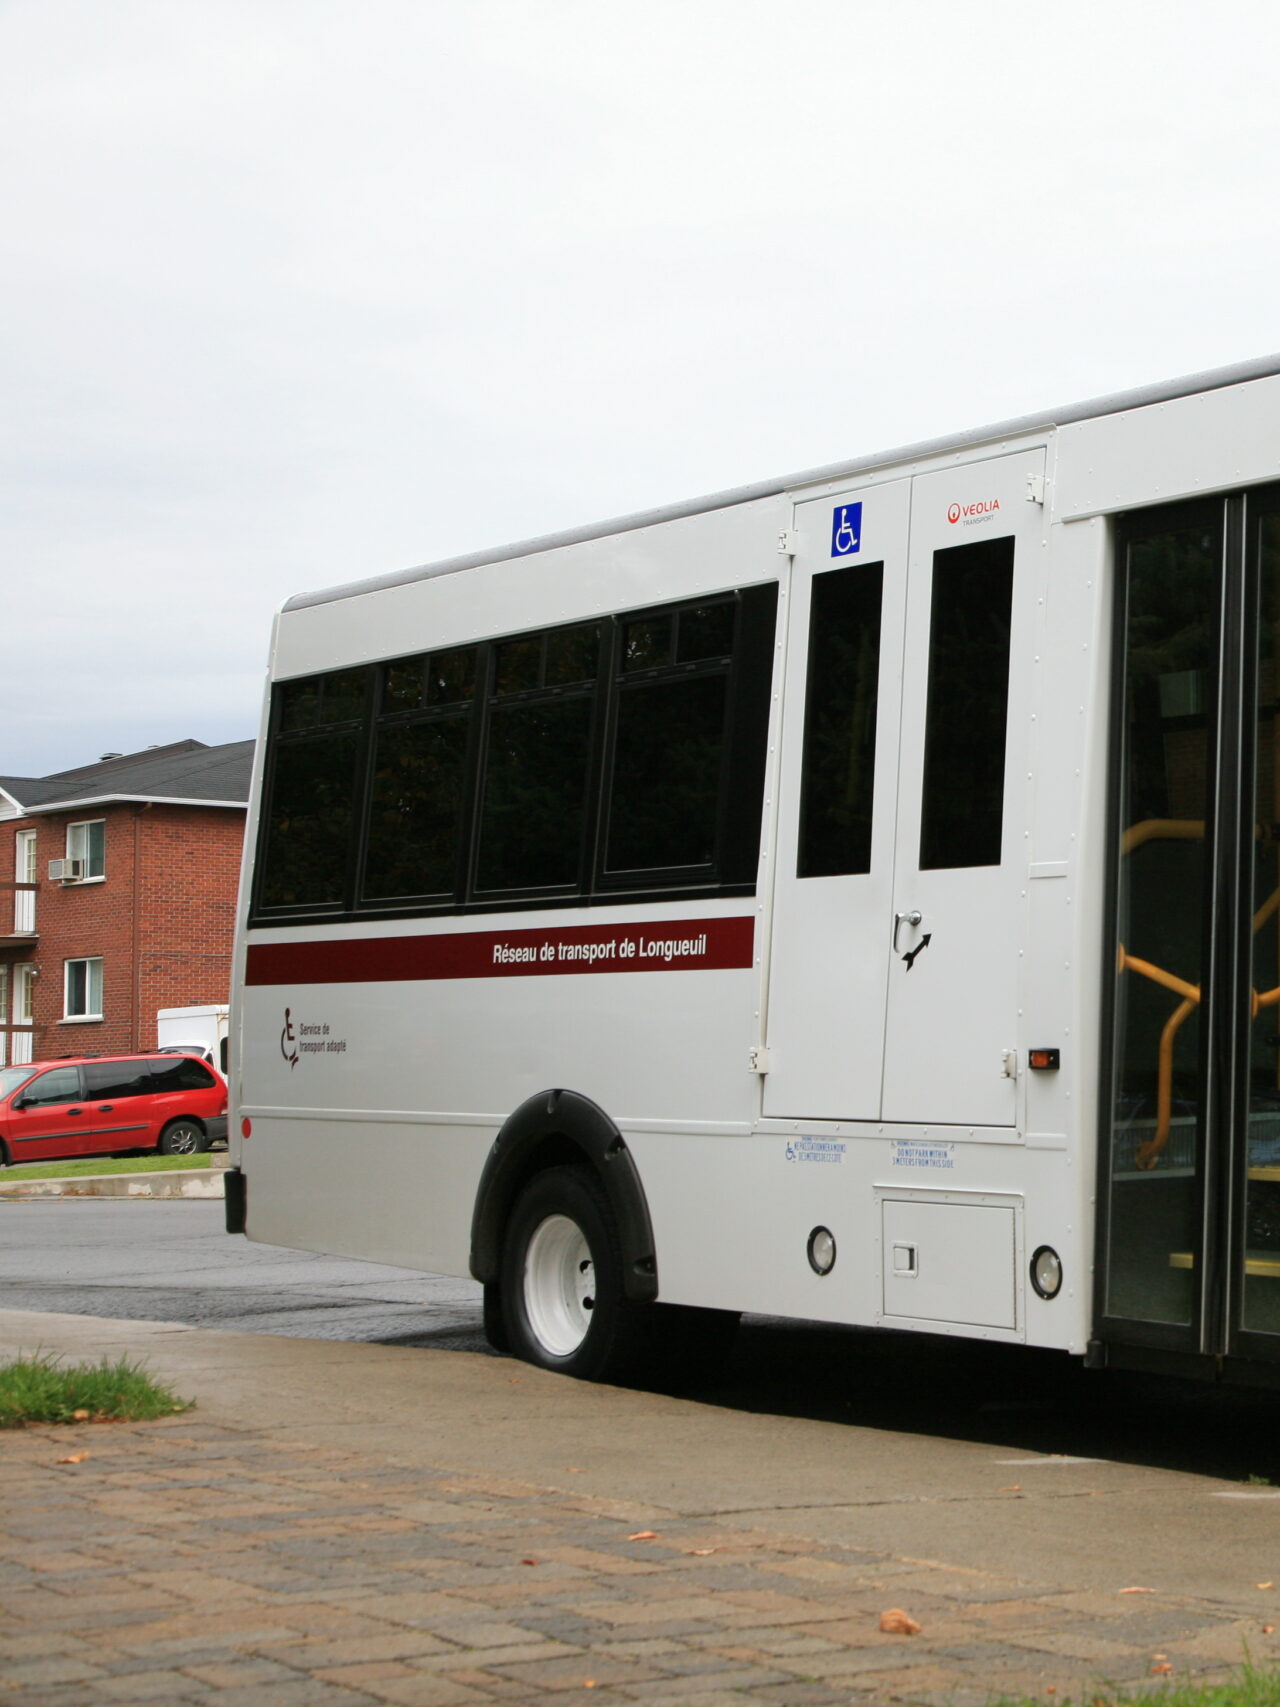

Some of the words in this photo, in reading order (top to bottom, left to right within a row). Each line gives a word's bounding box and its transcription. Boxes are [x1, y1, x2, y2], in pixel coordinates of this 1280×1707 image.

[962, 499, 1000, 517] VEOLIA
[963, 514, 994, 526] TRANSPORT
[492, 943, 537, 964] Réseau
[540, 942, 555, 961] de
[558, 940, 616, 964] transport
[619, 938, 636, 958] de
[639, 934, 707, 961] Longueuil
[299, 1023, 321, 1035] Service
[322, 1023, 330, 1035] de
[299, 1040, 325, 1055] transport
[326, 1039, 347, 1055] adapté
